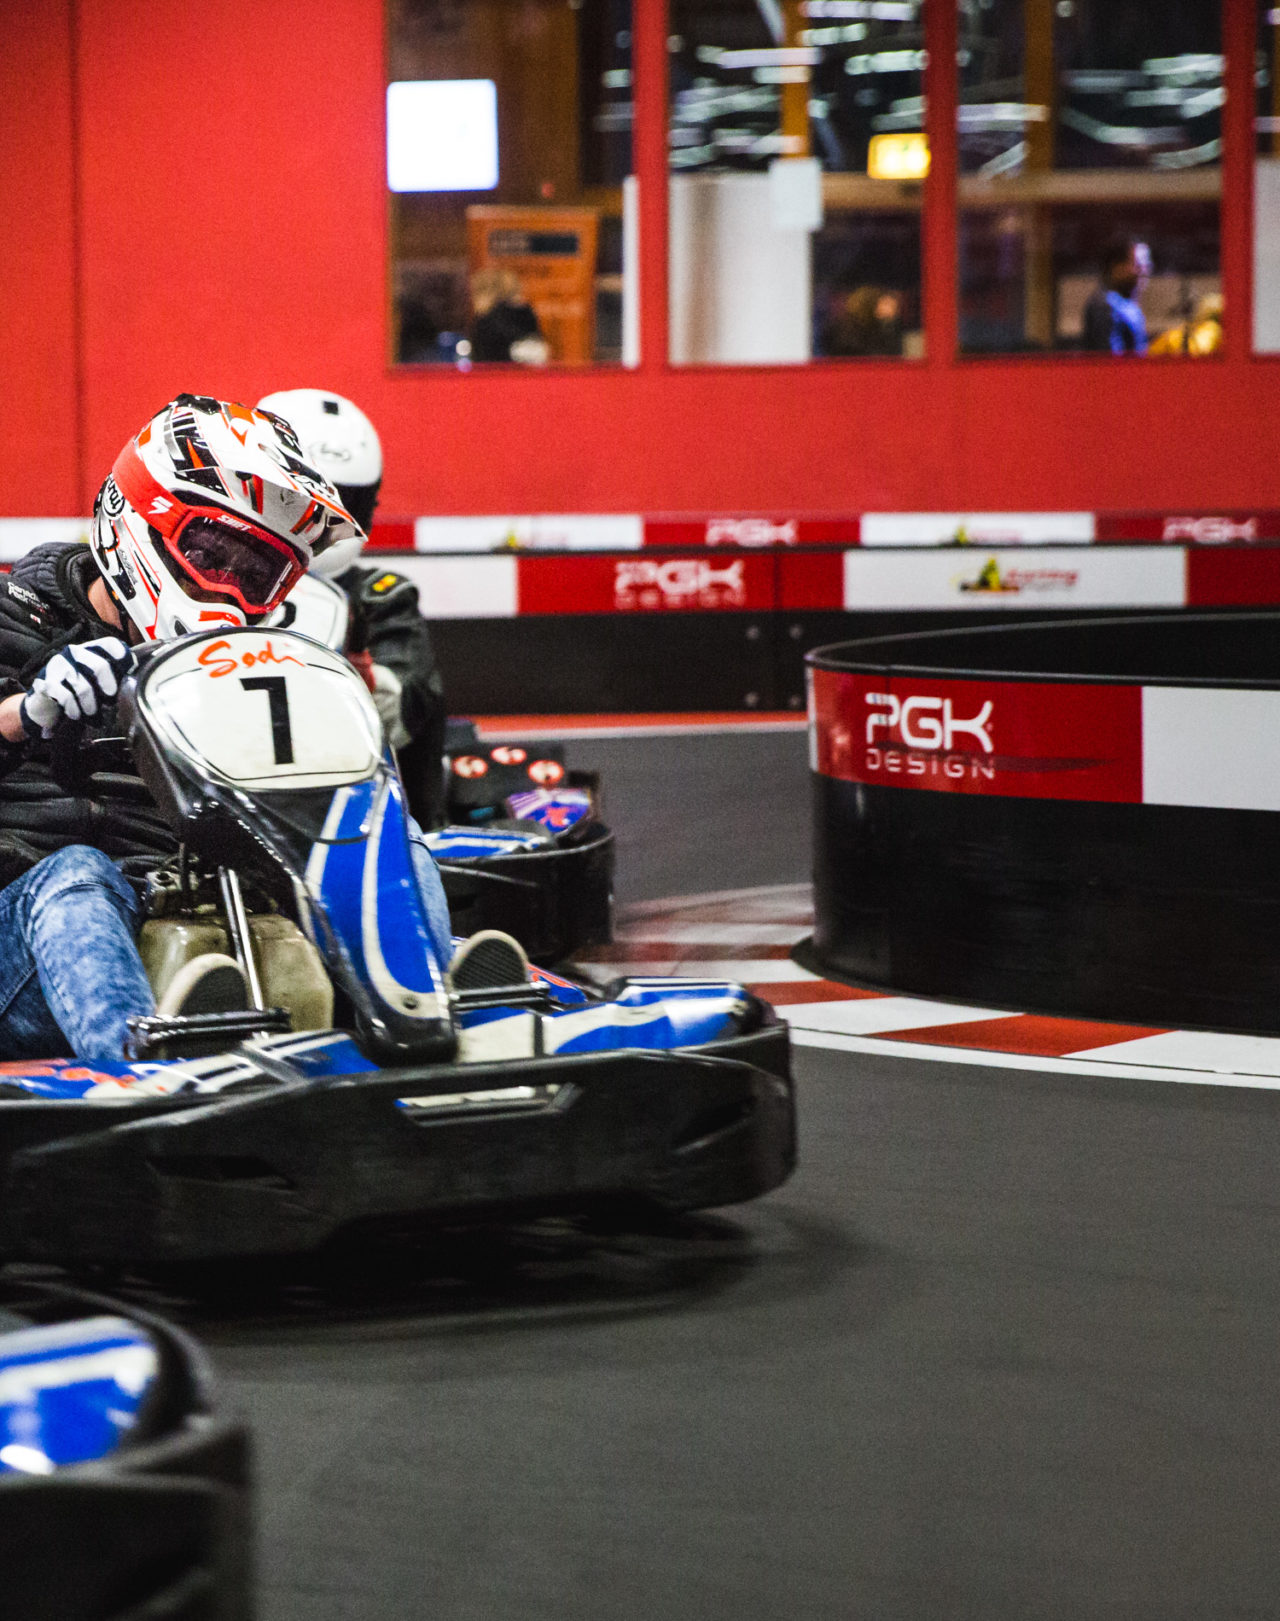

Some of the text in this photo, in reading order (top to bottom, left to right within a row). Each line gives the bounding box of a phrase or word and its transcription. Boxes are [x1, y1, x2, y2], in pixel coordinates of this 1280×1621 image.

[217, 514, 251, 531] SHIFT
[615, 560, 745, 594] PGK
[239, 676, 294, 765] 1
[865, 692, 994, 753] PGK
[866, 748, 995, 779] DESIGN
